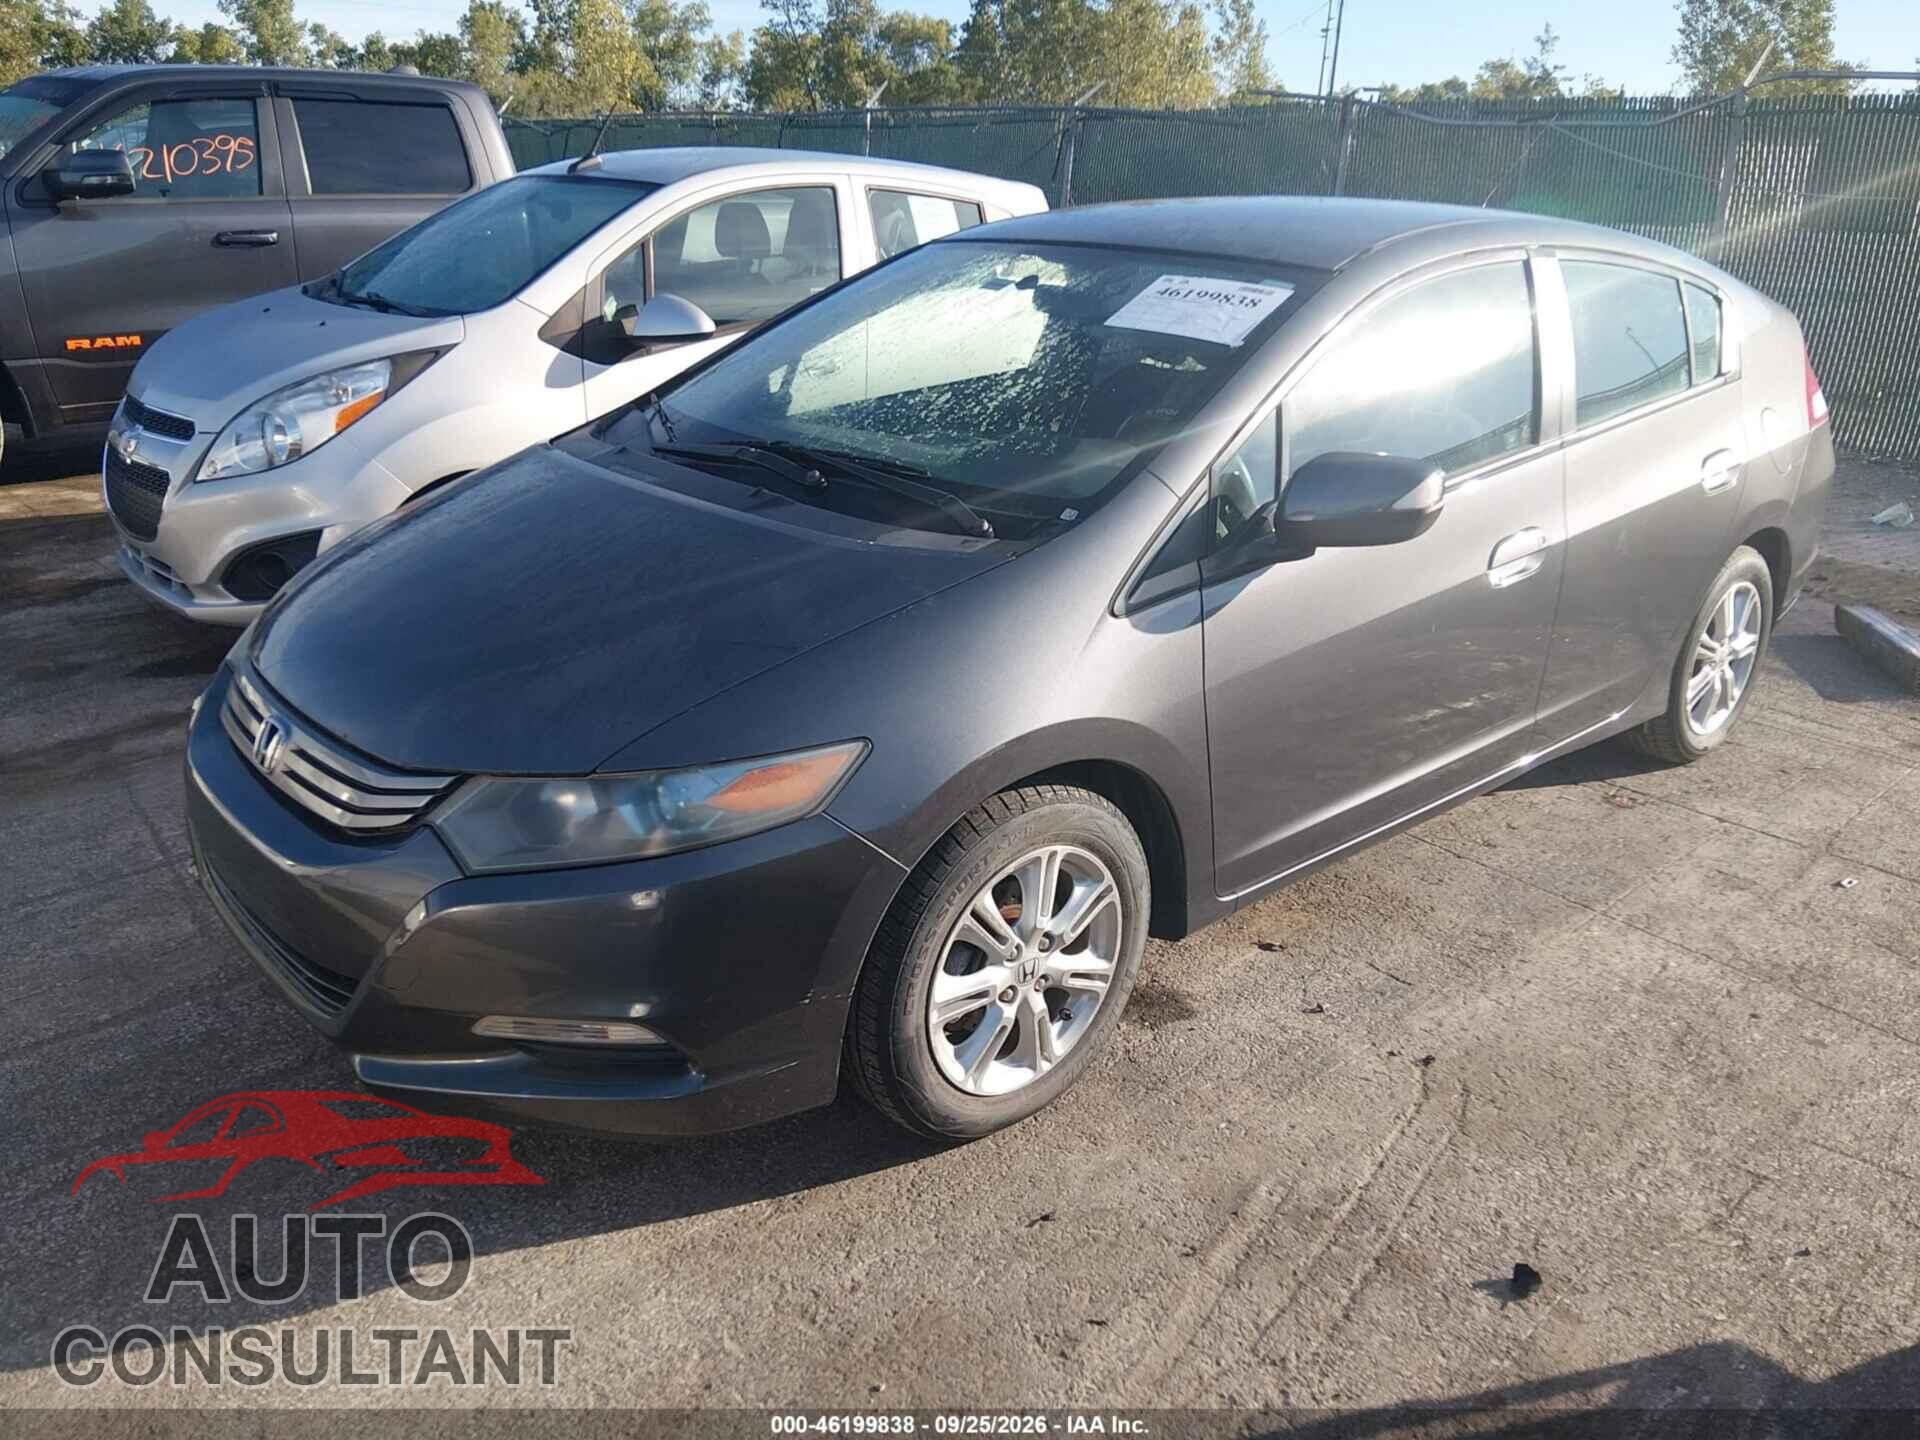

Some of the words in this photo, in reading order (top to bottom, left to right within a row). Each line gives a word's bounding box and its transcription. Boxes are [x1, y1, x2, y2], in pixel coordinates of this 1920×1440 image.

[113, 134, 255, 183] 210395
[1158, 286, 1261, 308] 46199838
[66, 335, 141, 351] RAM
